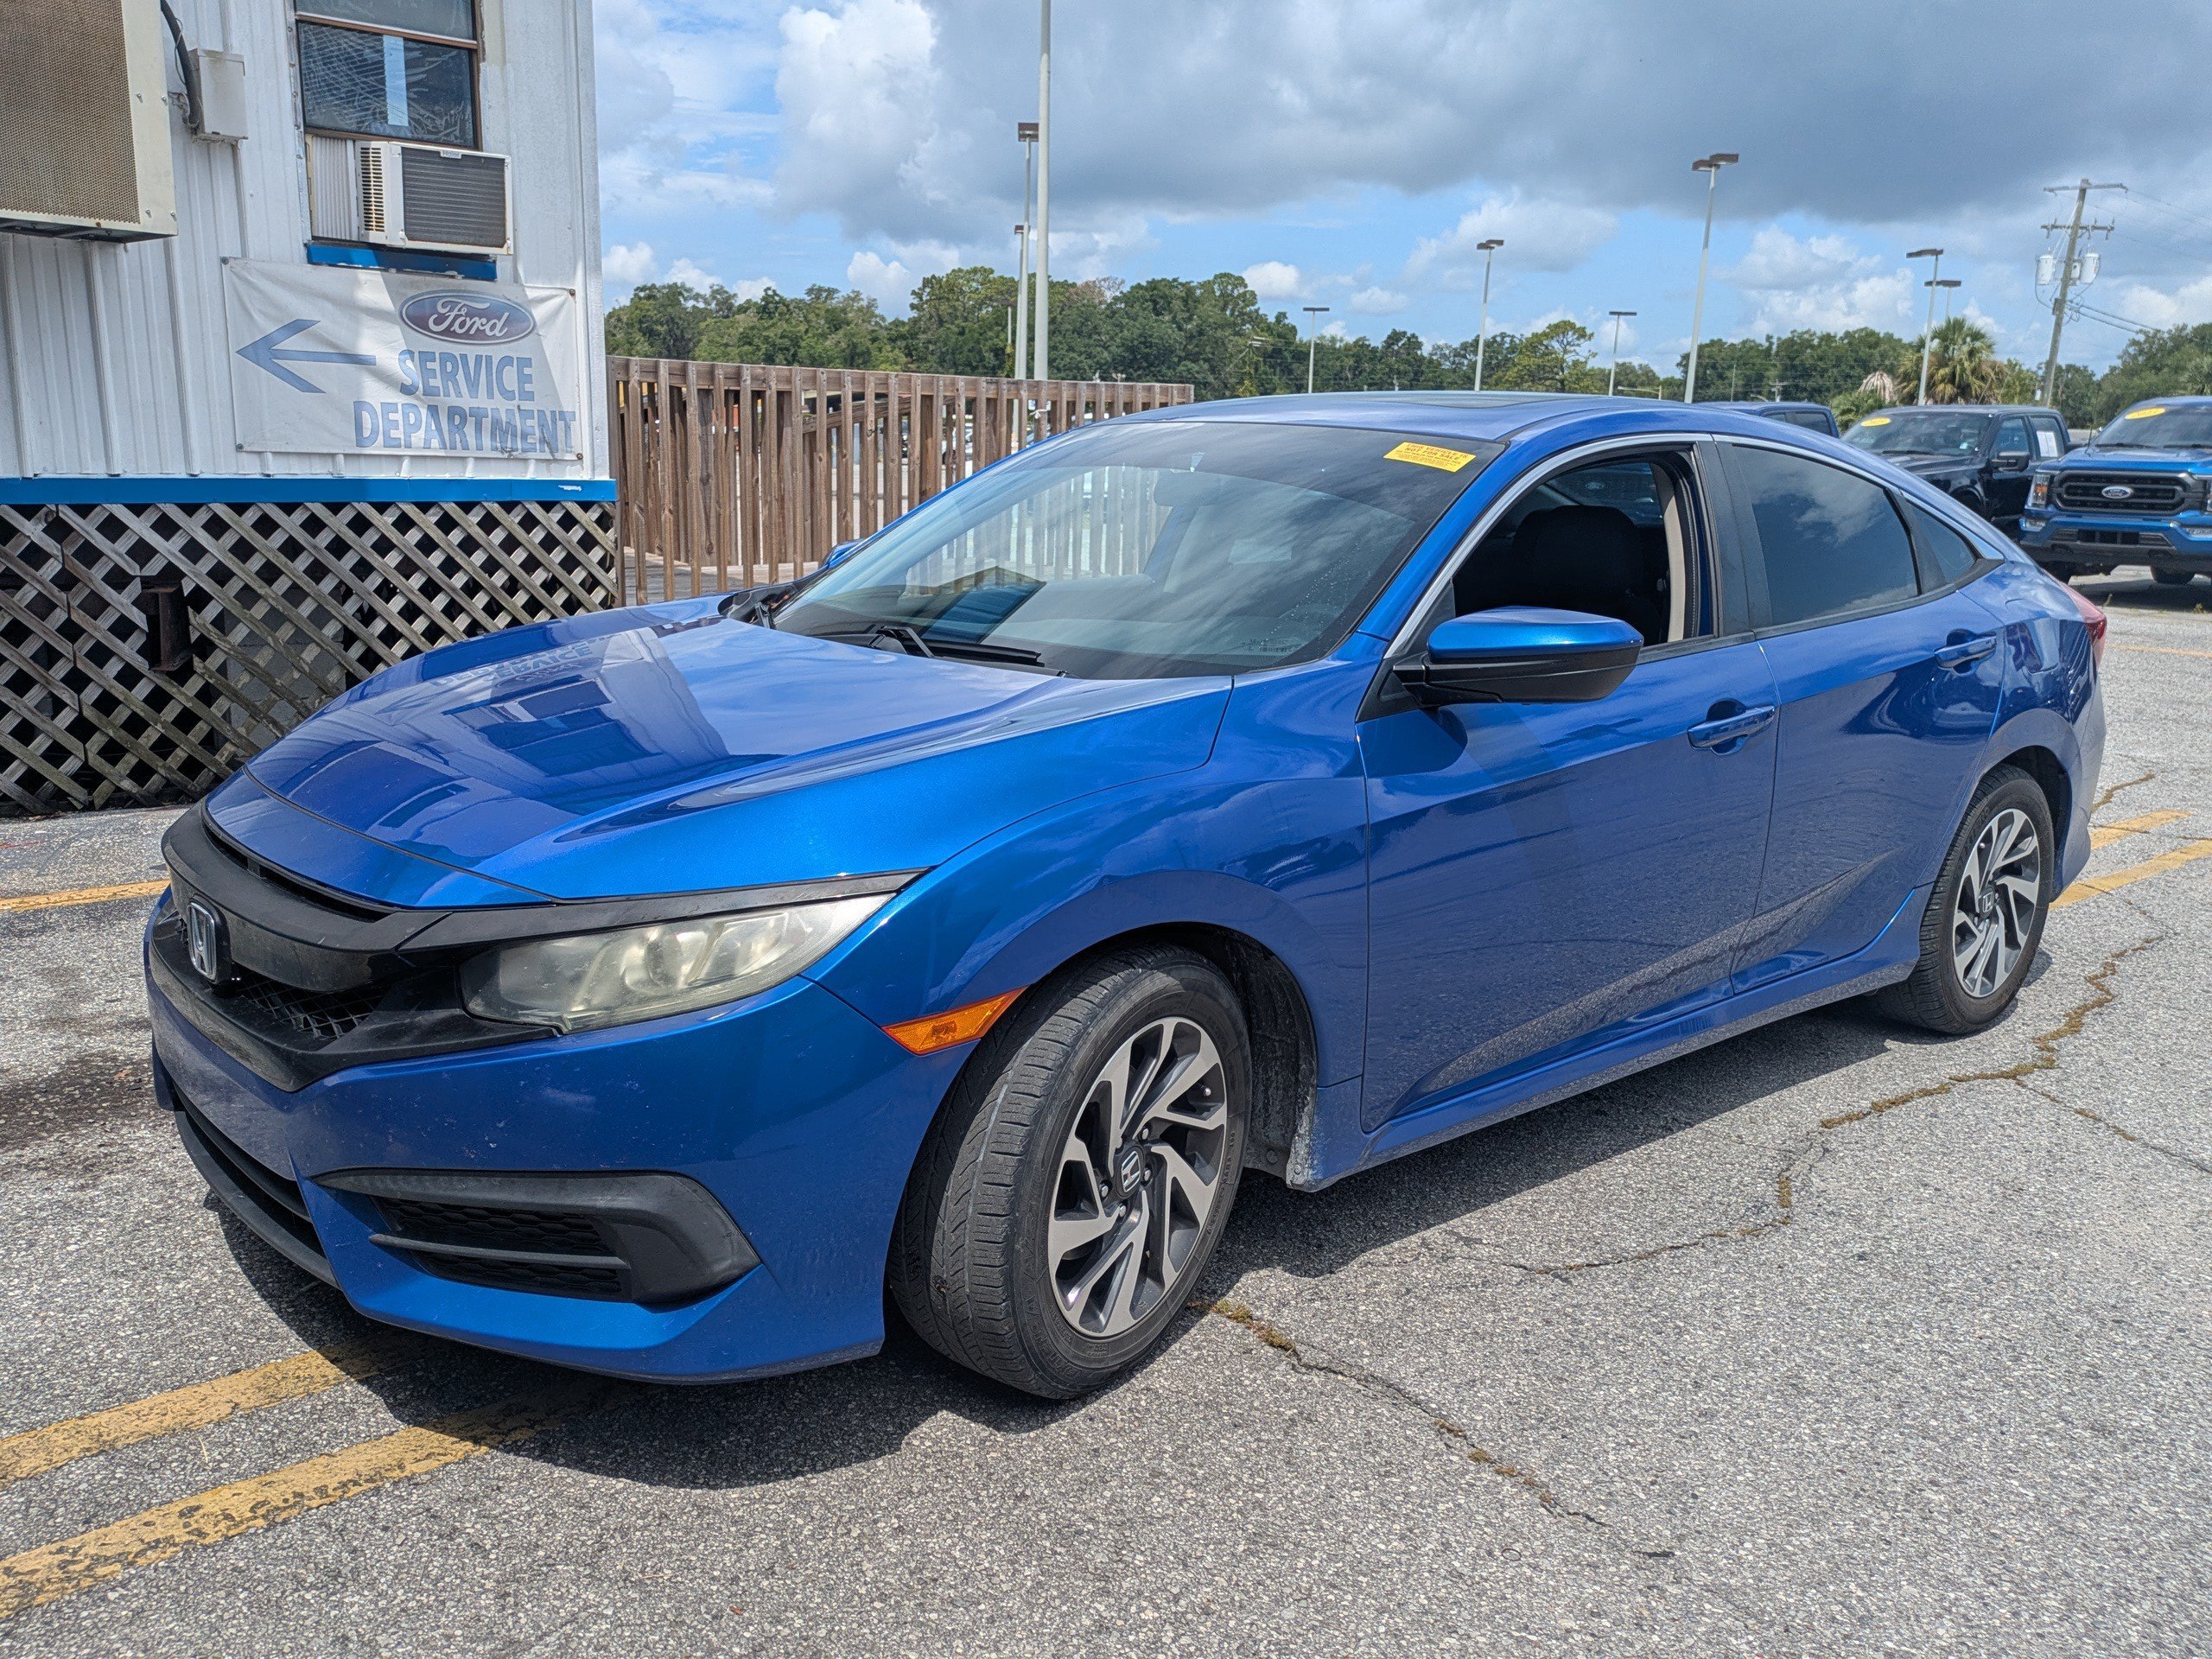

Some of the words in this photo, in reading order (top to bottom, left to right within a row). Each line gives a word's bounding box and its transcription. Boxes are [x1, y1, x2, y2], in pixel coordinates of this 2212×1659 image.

[429, 298, 510, 337] Ford
[397, 349, 535, 402] SERVICE
[353, 400, 576, 454] DEPARTMENT
[1426, 446, 1457, 455] VEHICLE
